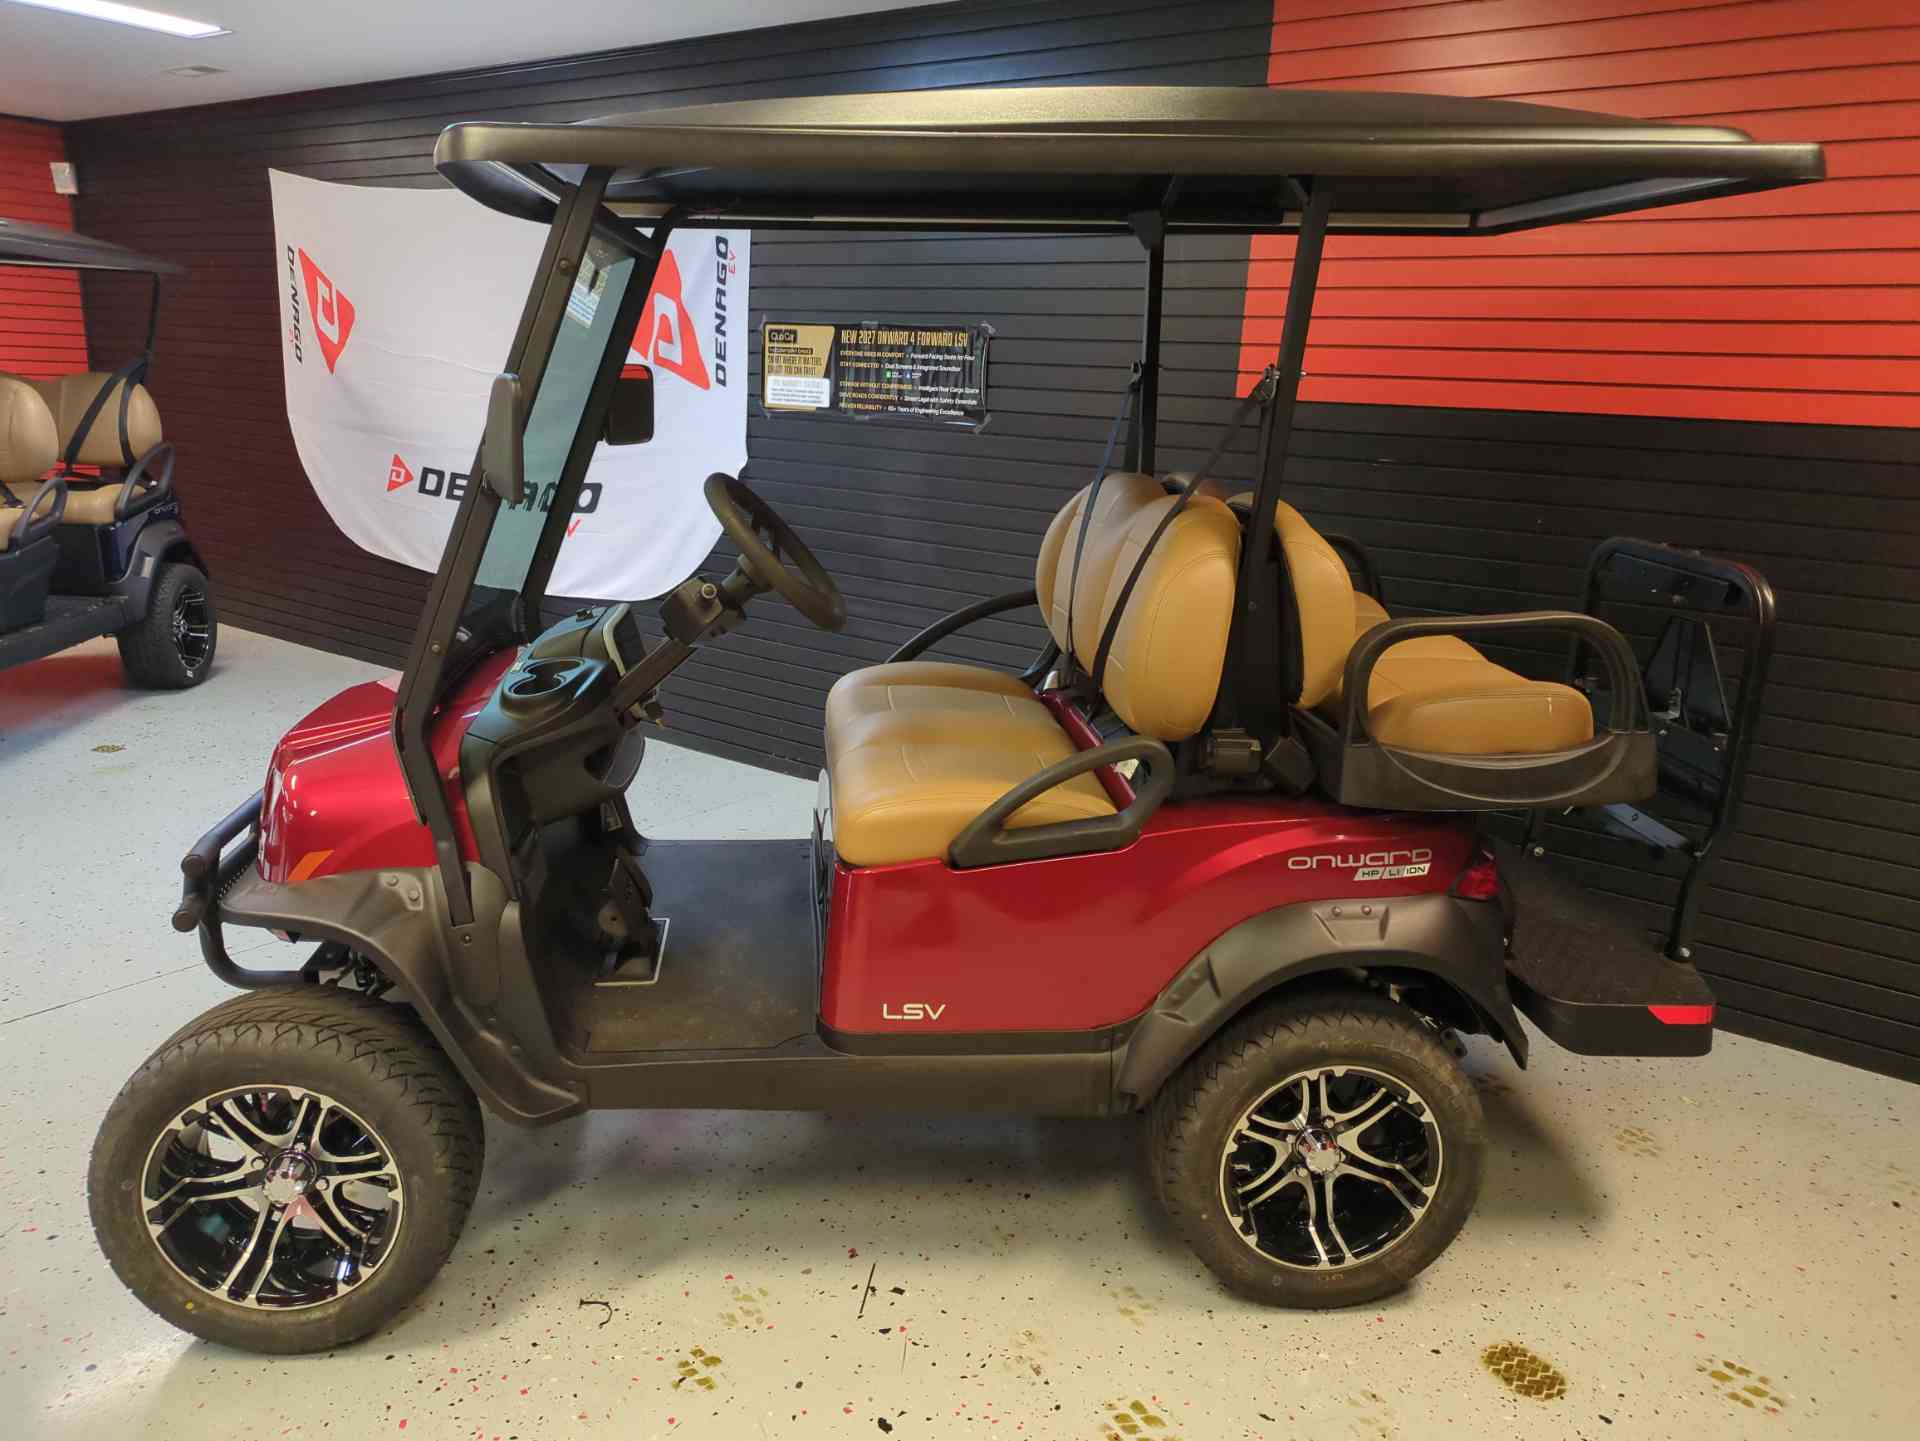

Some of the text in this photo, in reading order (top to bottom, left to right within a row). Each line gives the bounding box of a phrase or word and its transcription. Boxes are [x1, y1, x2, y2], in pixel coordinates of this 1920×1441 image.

[728, 249, 736, 274] EV
[287, 245, 303, 365] DENAGO
[714, 235, 728, 388] DENAGO
[841, 330, 856, 344] NEW
[877, 331, 909, 345] ONWARD
[917, 332, 953, 346] FORWARD
[882, 1003, 946, 1020] LSV
